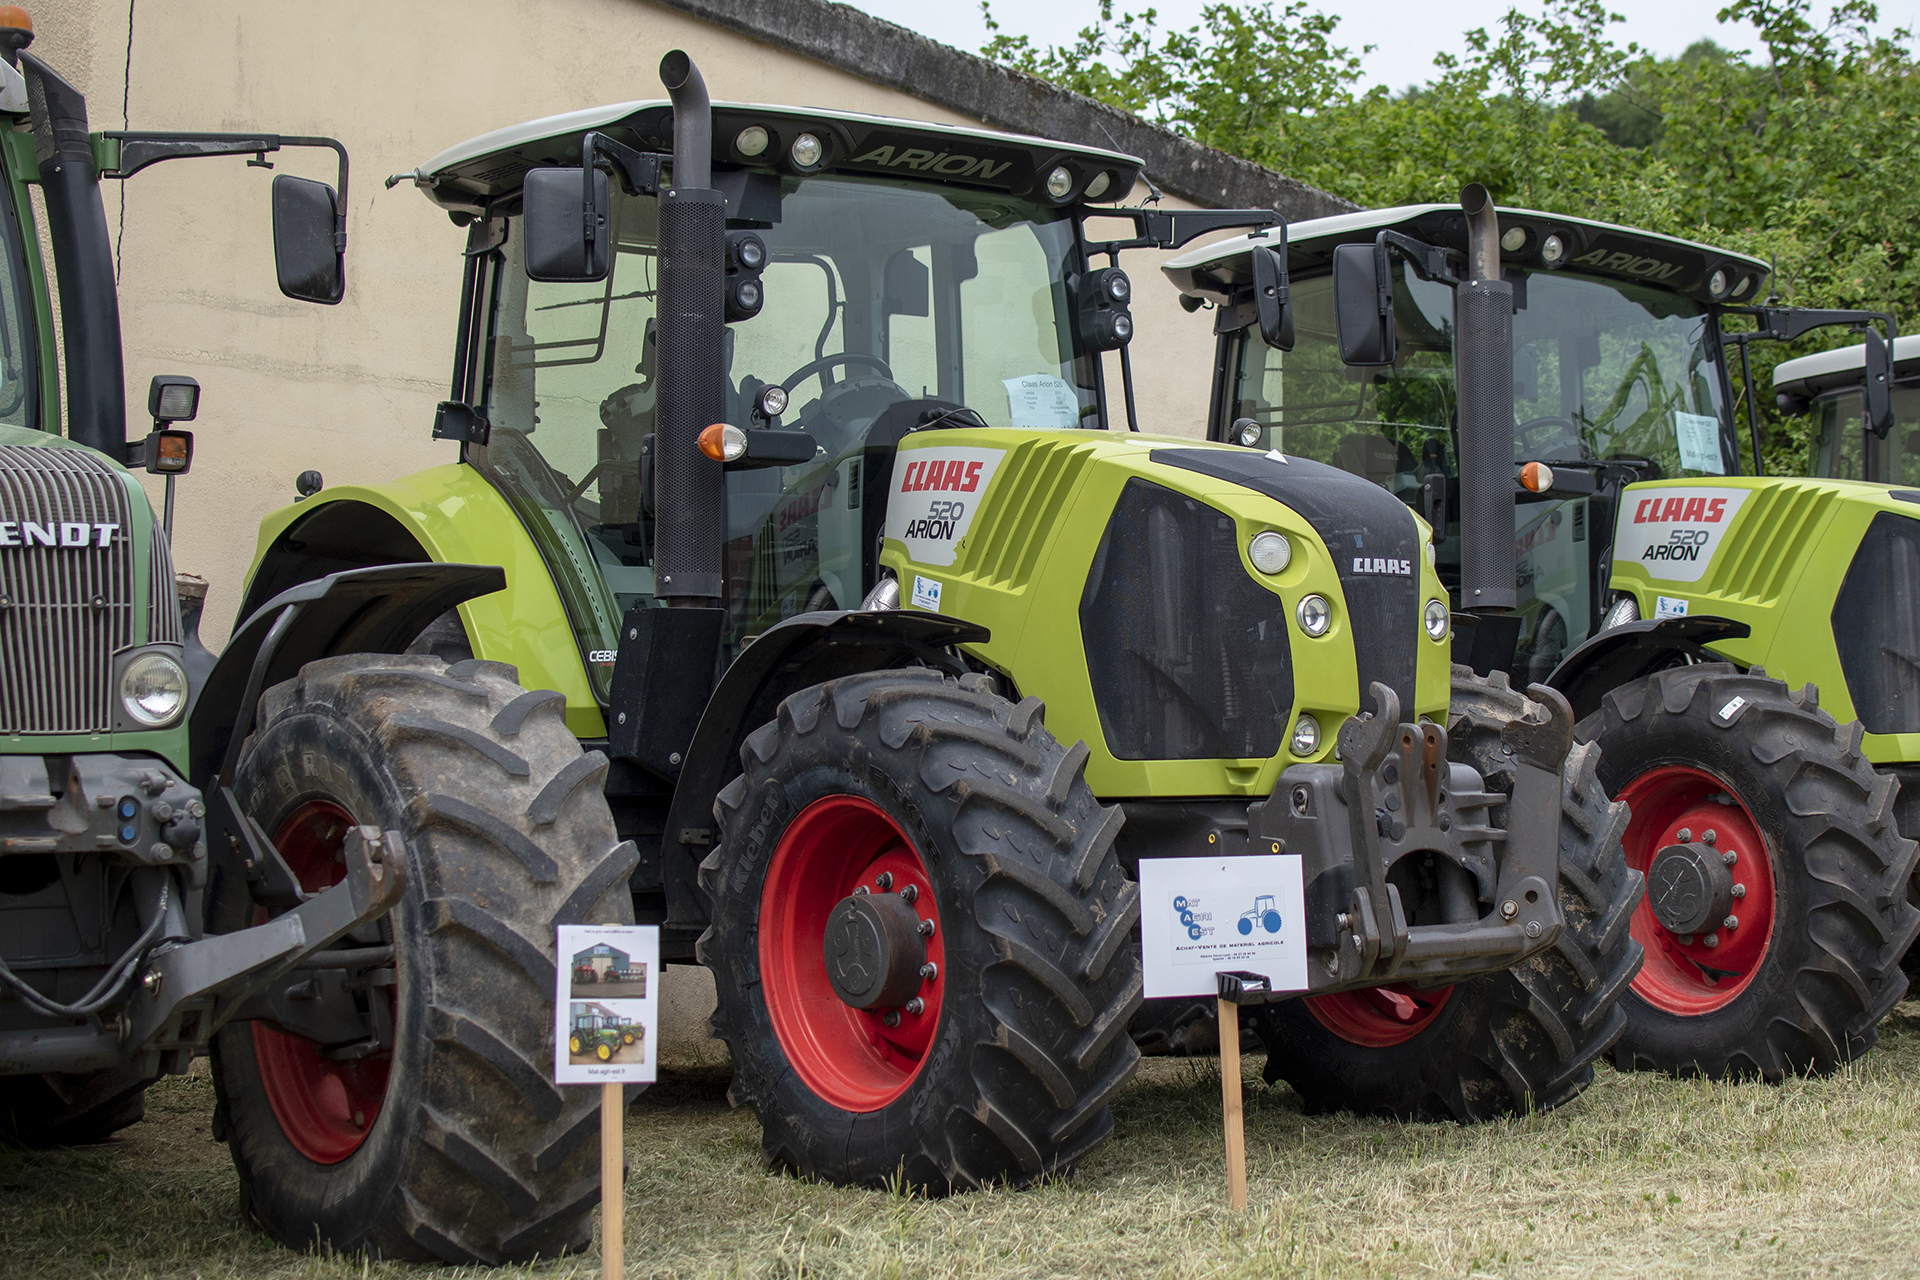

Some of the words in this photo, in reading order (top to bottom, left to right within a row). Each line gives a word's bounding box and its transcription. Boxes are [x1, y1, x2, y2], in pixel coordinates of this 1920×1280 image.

[851, 145, 1013, 179] ARION
[1572, 248, 1684, 280] ARION
[1021, 380, 1038, 388] Claas
[1039, 380, 1053, 388] Arion
[901, 460, 984, 493] CLAAS
[927, 501, 965, 521] 520
[1633, 497, 1728, 524] CLAAS
[0, 521, 120, 548] ENDT
[904, 519, 956, 540] ARION
[1668, 530, 1709, 546] 520
[1641, 545, 1700, 561] ARION
[1353, 557, 1411, 575] CLAAS
[729, 786, 780, 894] Kleber
[1176, 898, 1200, 908] MAT
[1183, 911, 1212, 922] AGRI
[1191, 927, 1215, 937] EST
[909, 1017, 961, 1126] Kleber
